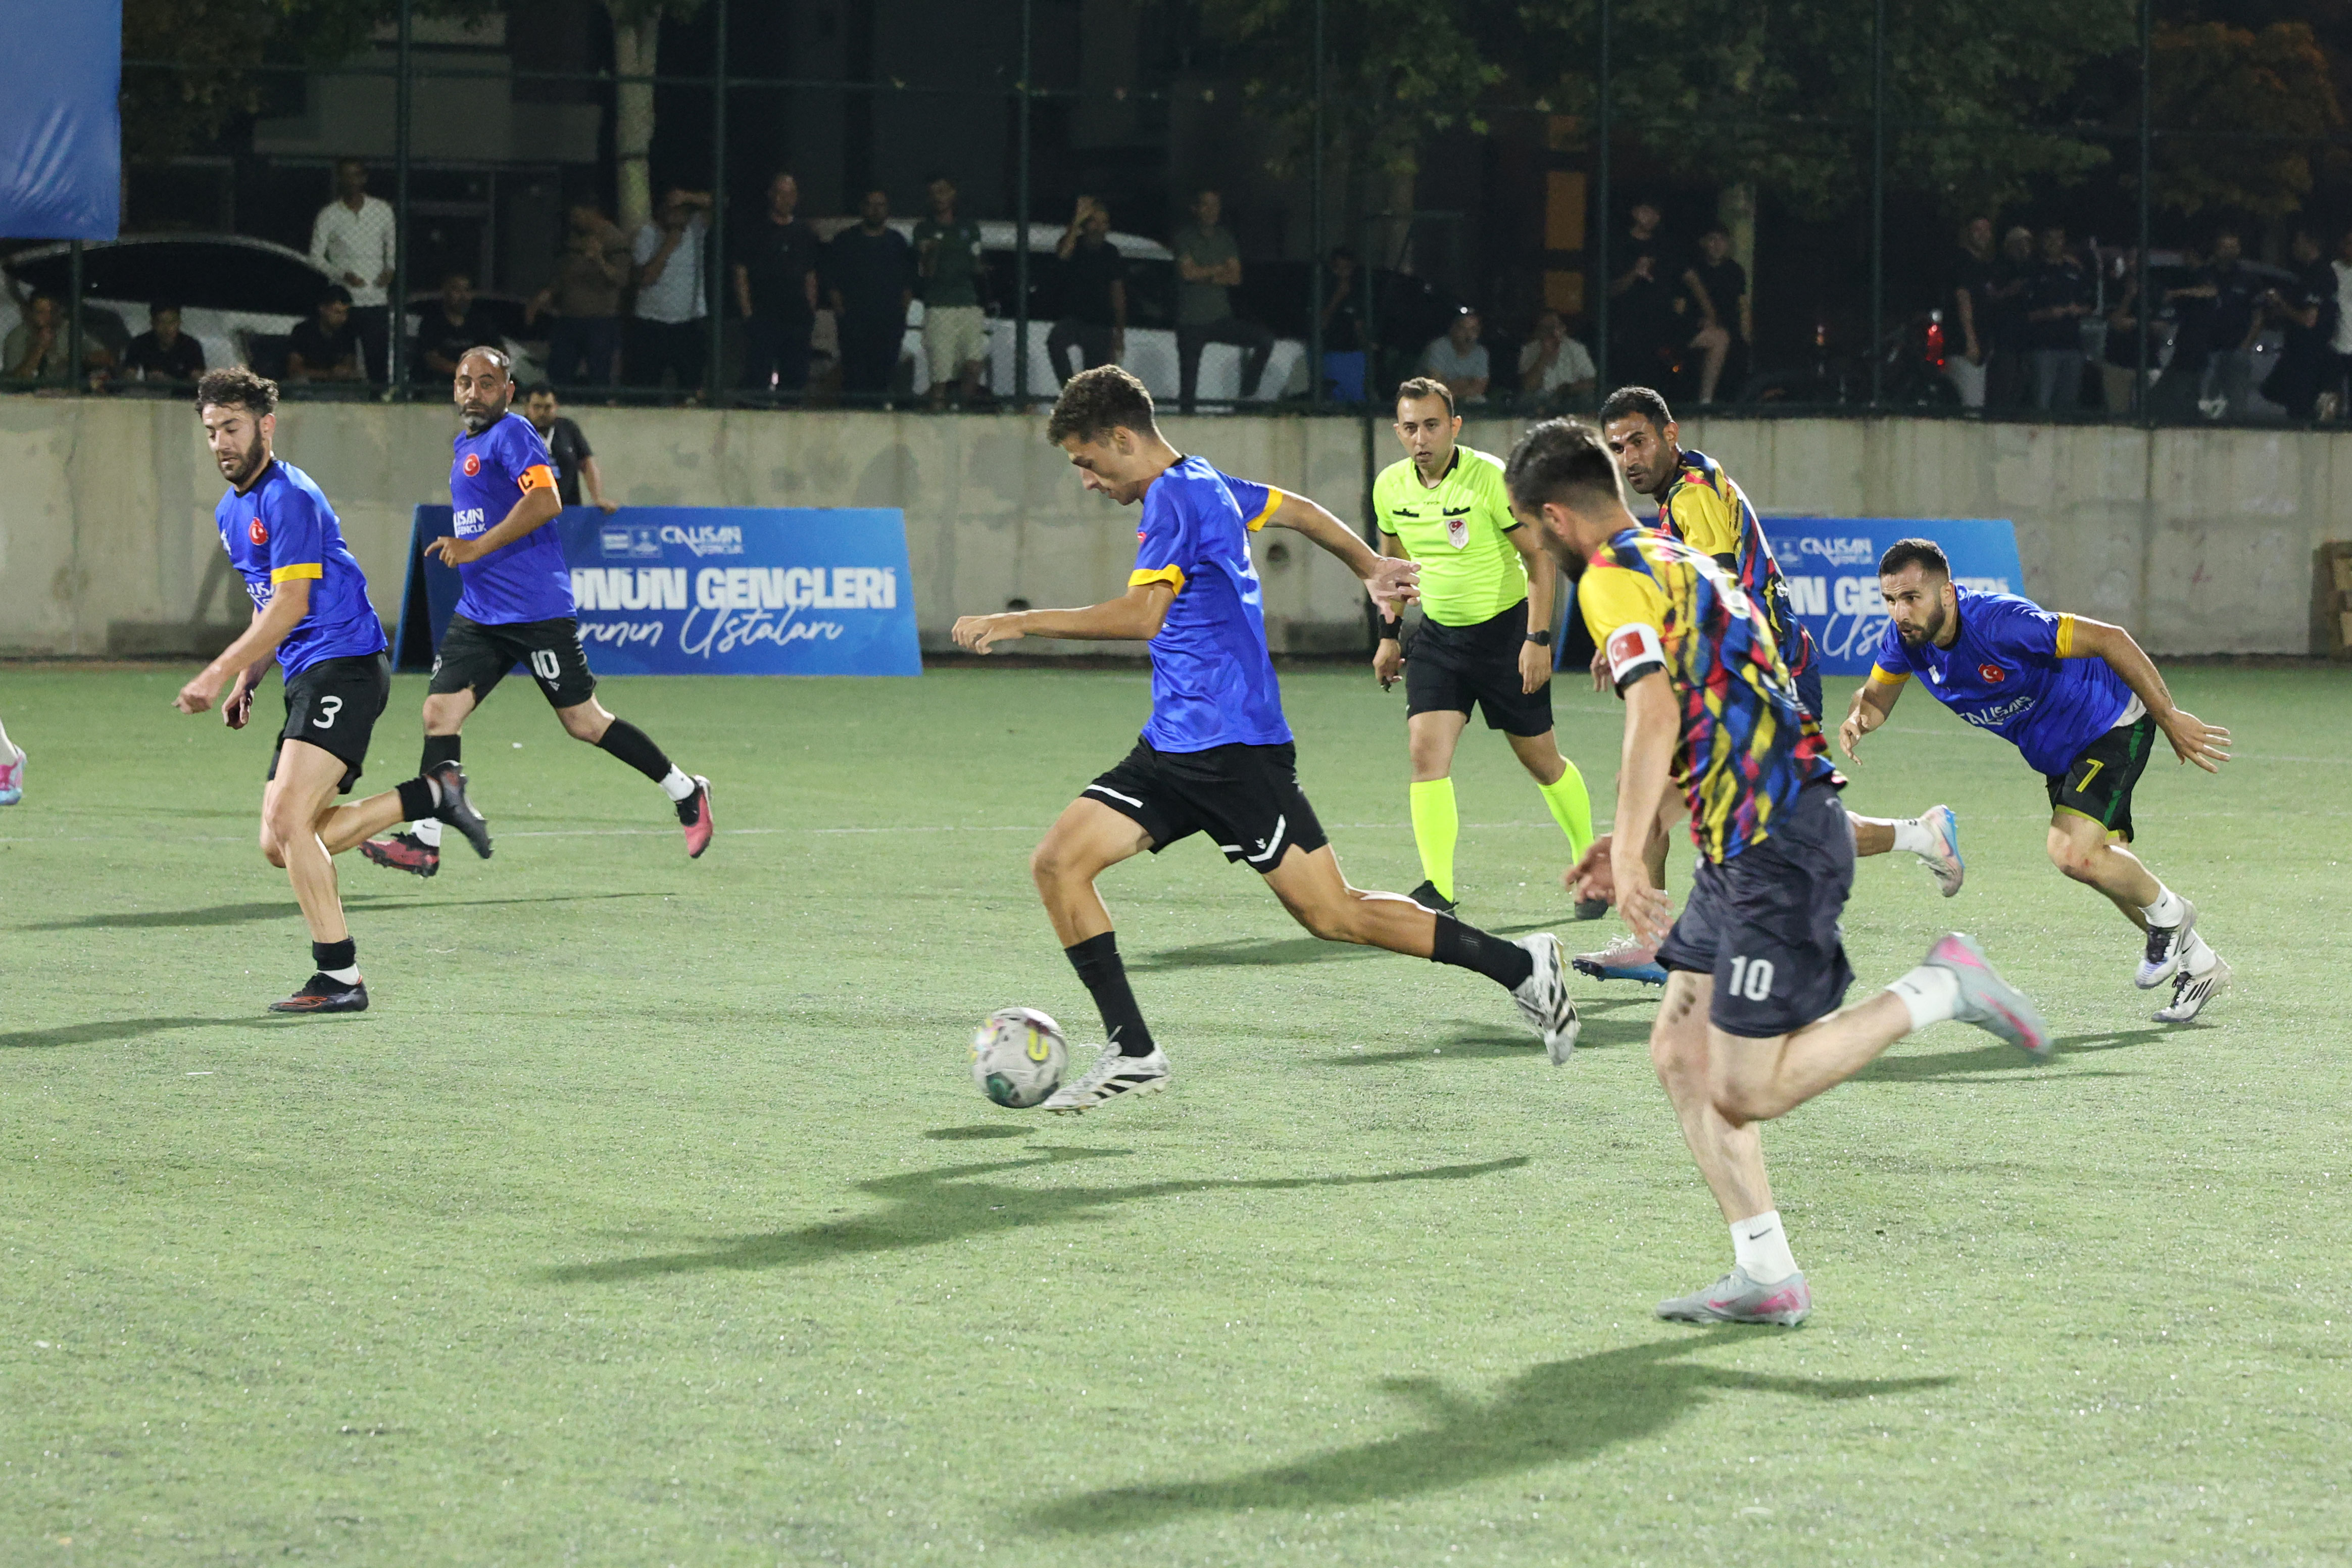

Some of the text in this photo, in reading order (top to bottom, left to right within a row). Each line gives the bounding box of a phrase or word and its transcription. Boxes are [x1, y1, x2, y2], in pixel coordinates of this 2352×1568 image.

[531, 649, 560, 679] 10
[313, 695, 343, 728] 3
[2076, 758, 2104, 793] 7
[1729, 955, 1774, 1001] 10
